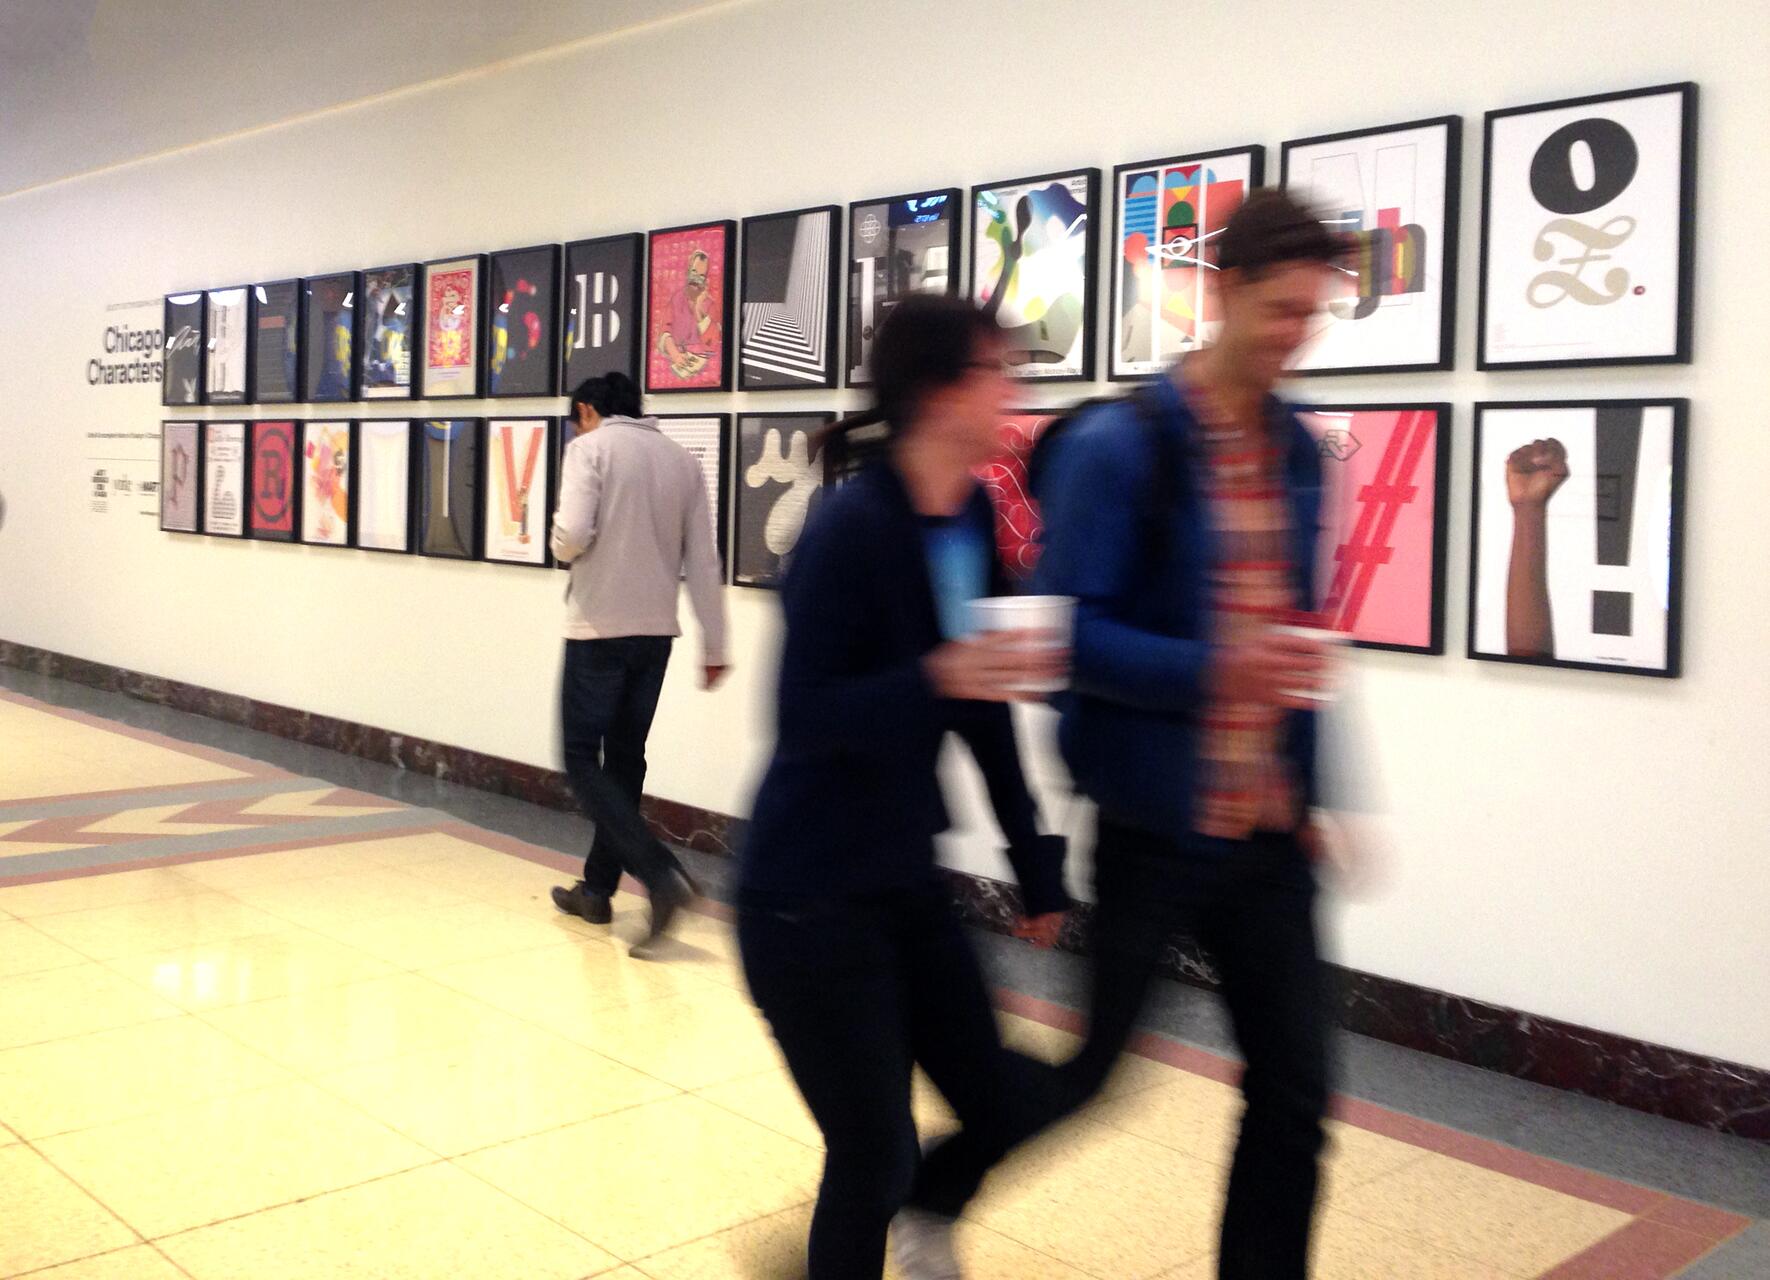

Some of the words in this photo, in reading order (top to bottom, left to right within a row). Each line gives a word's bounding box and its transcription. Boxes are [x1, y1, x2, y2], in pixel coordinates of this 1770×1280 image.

[104, 323, 163, 358] Chicago
[87, 358, 163, 385] Characters
[261, 449, 284, 499] R
